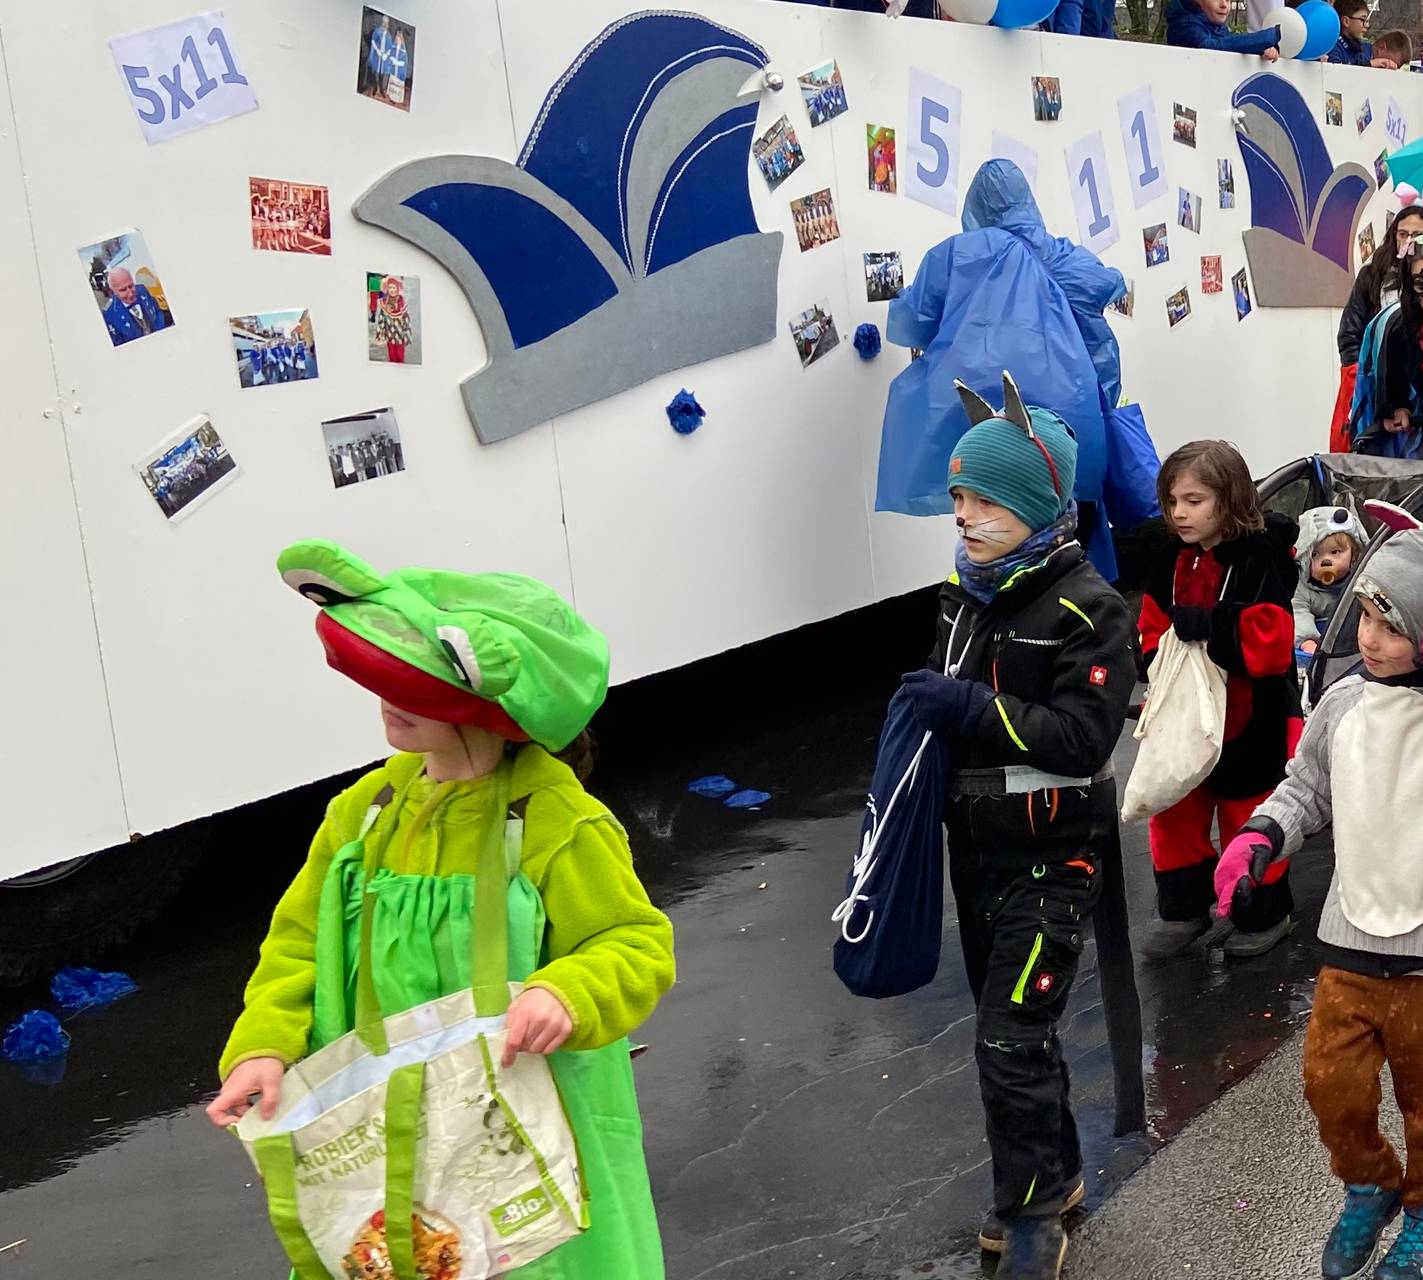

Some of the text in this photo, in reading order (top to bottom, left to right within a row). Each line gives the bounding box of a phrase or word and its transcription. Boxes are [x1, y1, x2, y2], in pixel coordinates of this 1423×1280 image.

[122, 27, 249, 125] 5x11
[916, 96, 950, 188] 5
[1131, 110, 1160, 187] 1
[1078, 157, 1111, 238] 1
[297, 1117, 386, 1171] ROBIER'S
